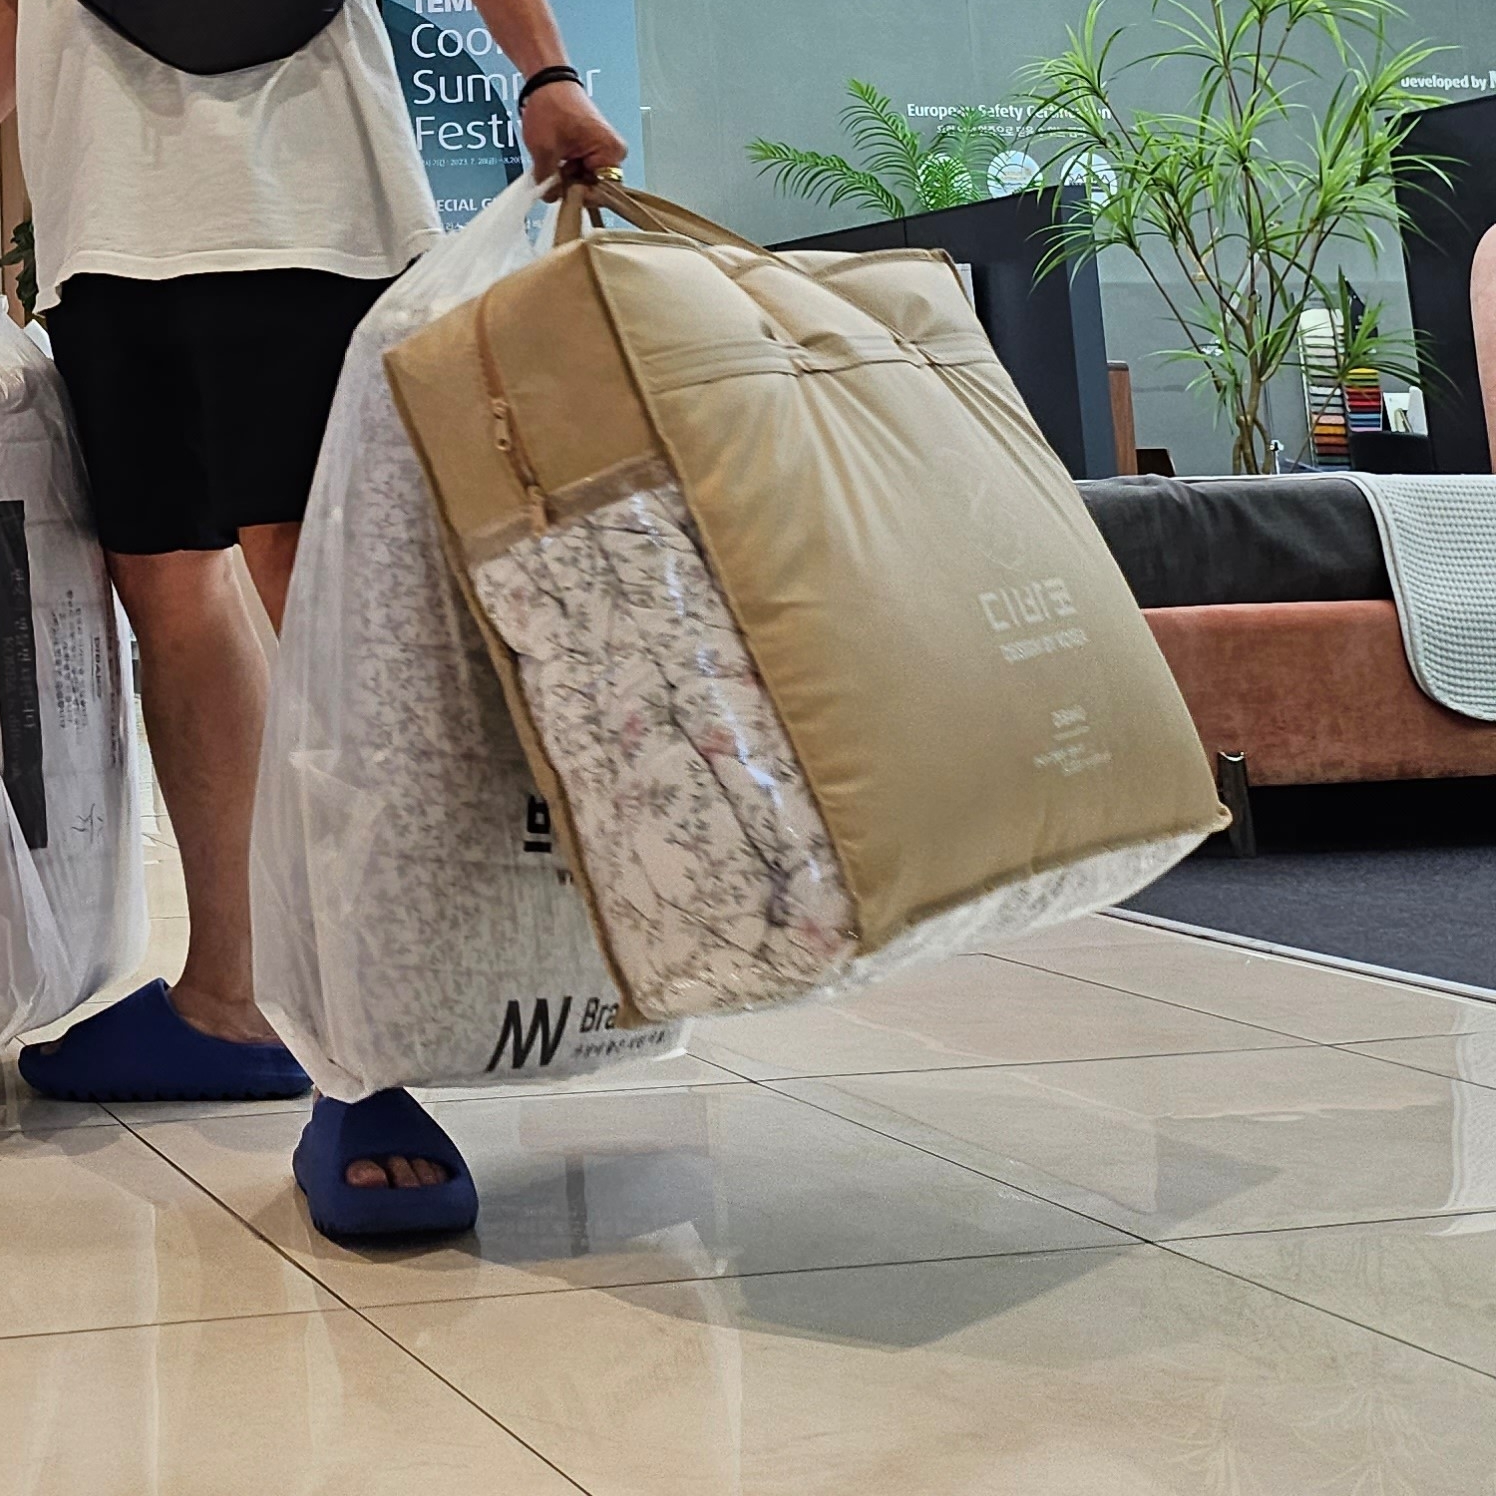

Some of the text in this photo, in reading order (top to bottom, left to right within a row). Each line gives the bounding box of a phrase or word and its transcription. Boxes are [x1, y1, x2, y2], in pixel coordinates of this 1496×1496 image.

[413, 69, 601, 104] Sumr
[1401, 75, 1469, 90] developed
[1471, 75, 1487, 91] by
[978, 104, 1023, 121] Safety
[415, 110, 522, 151] Festi
[437, 198, 477, 212] ECIAL
[579, 996, 620, 1034] Bra
